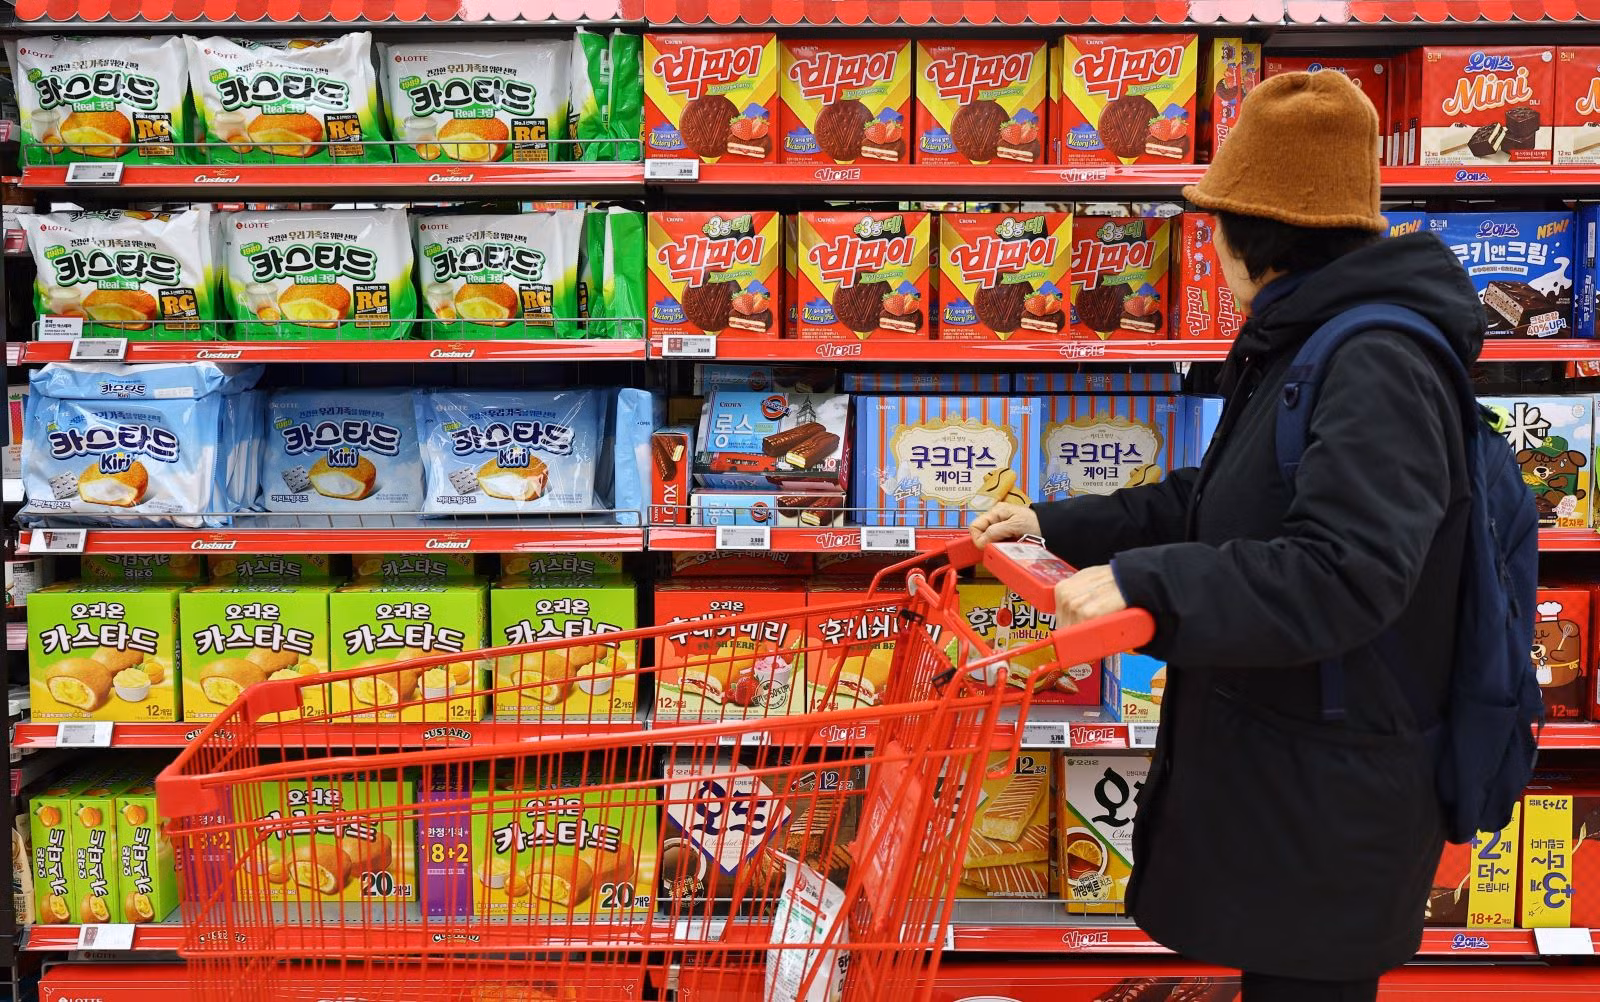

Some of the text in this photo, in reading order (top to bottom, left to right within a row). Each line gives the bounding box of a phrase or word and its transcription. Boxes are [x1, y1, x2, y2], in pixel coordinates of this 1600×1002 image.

[28, 50, 54, 59] LOTTE
[1463, 51, 1515, 73] 오예스
[426, 67, 446, 77] 건강한
[447, 64, 465, 73] 우리
[465, 63, 489, 74] 가족을
[653, 45, 763, 100] 빅파이
[788, 51, 898, 106] 빅파이
[926, 51, 1035, 106] 빅파이
[1073, 46, 1184, 102] 빅파이
[36, 71, 158, 108] 카스타드
[218, 73, 349, 110] 카스타드
[409, 77, 535, 115] 카스타드
[1442, 67, 1533, 116] Mini
[74, 102, 96, 111] Real
[455, 108, 494, 118] Real 크림
[136, 119, 169, 138] RC
[328, 119, 361, 140] RC
[514, 126, 546, 142] RC
[194, 175, 240, 184] Custard
[428, 173, 475, 183] Custard
[815, 168, 861, 181] VICPIE
[1455, 169, 1491, 182] 오예스
[268, 230, 358, 244] 건강한 우리 가족을 위한 선택
[1390, 220, 1422, 237] NEW!
[1476, 220, 1519, 239] 오예스
[1536, 219, 1569, 240] NEW!
[251, 244, 376, 281] 카스타드
[657, 235, 765, 289] 빅파이
[808, 235, 916, 289] 빅파이
[1450, 241, 1548, 266] 쿠키앤크림
[53, 251, 179, 284] 카스타드
[432, 245, 545, 282] 카스타드
[950, 236, 1058, 290] 빅파이
[1071, 240, 1157, 291] 빅파이
[98, 280, 119, 290] Real
[295, 274, 335, 284] Real 크림
[467, 274, 486, 283] Real
[161, 295, 196, 314] RC
[356, 291, 387, 309] RC
[521, 291, 551, 309] RC
[1527, 318, 1566, 336] 40% UP!
[197, 350, 242, 359] Custard
[430, 349, 476, 358] Custard
[816, 344, 861, 357] VICPIE
[101, 383, 146, 394] 카스타드
[282, 420, 402, 456] 카스타드
[451, 421, 575, 456] 카스타드
[714, 413, 753, 449] 롱스
[49, 424, 180, 463] 카스타드
[100, 452, 132, 473] Kiri
[328, 448, 359, 467] Kiri
[910, 445, 997, 470] 쿠크다스
[1059, 442, 1143, 465] 쿠크다스
[935, 470, 973, 485] 케이크
[1083, 466, 1119, 480] 케이크
[191, 539, 237, 550] Custard
[425, 539, 472, 549] Custard
[816, 532, 861, 548] VICPIE
[125, 568, 153, 578] 오리온
[236, 559, 302, 577] 카스타드
[382, 559, 448, 576] 카스타드
[529, 557, 596, 575] 카스타드
[71, 602, 125, 620] 오리온
[225, 602, 280, 620] 오리온
[376, 602, 431, 620] 오리온
[536, 598, 590, 615] 오리온
[710, 601, 745, 612] 오리온
[40, 622, 159, 655] 카스타드
[193, 623, 314, 656] 카스타드
[343, 622, 465, 655] 카스타드
[505, 618, 623, 648] 카스타드
[146, 704, 172, 717] 12개입
[450, 705, 477, 717] 12개입
[658, 697, 687, 709] 12개입
[1122, 703, 1149, 715] 12개입
[423, 727, 471, 741] CUSTARD
[1071, 726, 1115, 744] VICPIE
[1014, 756, 1047, 775] 12조각
[288, 788, 343, 806] 오리온
[526, 797, 585, 817] 오리온
[493, 818, 621, 853] 카스타드
[1530, 839, 1565, 850] 드립니다
[37, 848, 47, 878] 오리온
[47, 829, 67, 897] 카스타드
[78, 848, 88, 879] 오리온
[88, 830, 107, 897] 카스타드
[122, 846, 131, 877] 오리온
[132, 827, 152, 895] 카스타드
[360, 871, 413, 898] 20개입
[1477, 883, 1510, 893] 드립니다
[601, 882, 650, 909] 20개입
[1063, 931, 1108, 948] VICPIE
[1452, 933, 1489, 949] 오예스
